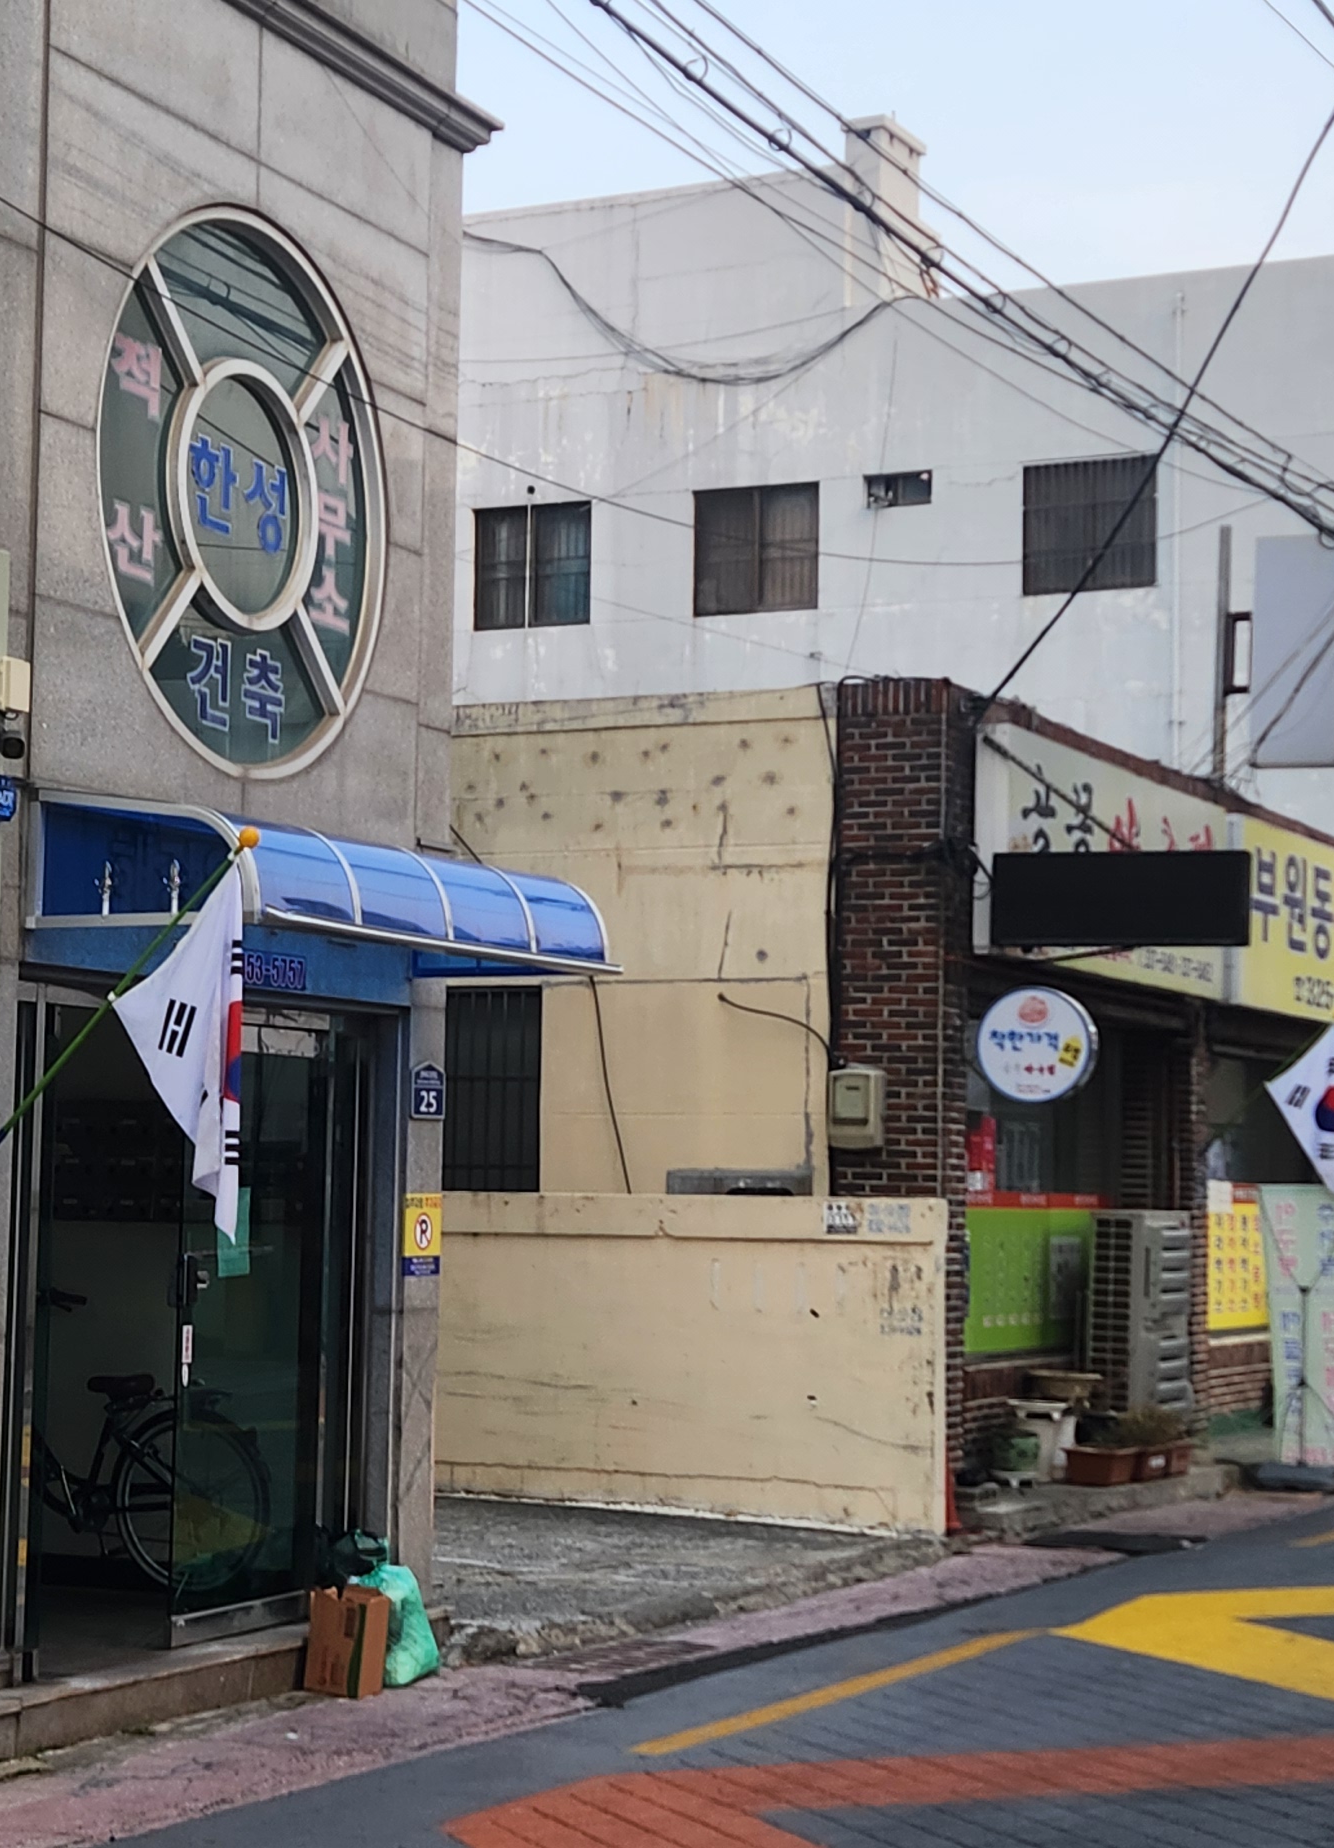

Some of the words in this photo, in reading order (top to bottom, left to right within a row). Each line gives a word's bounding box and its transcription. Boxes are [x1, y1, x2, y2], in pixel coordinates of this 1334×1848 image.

[189, 433, 289, 557] 한성
[311, 412, 354, 636] 사무소
[187, 636, 287, 744] 건축
[244, 951, 305, 990] 53-5757
[419, 1090, 437, 1113] 25
